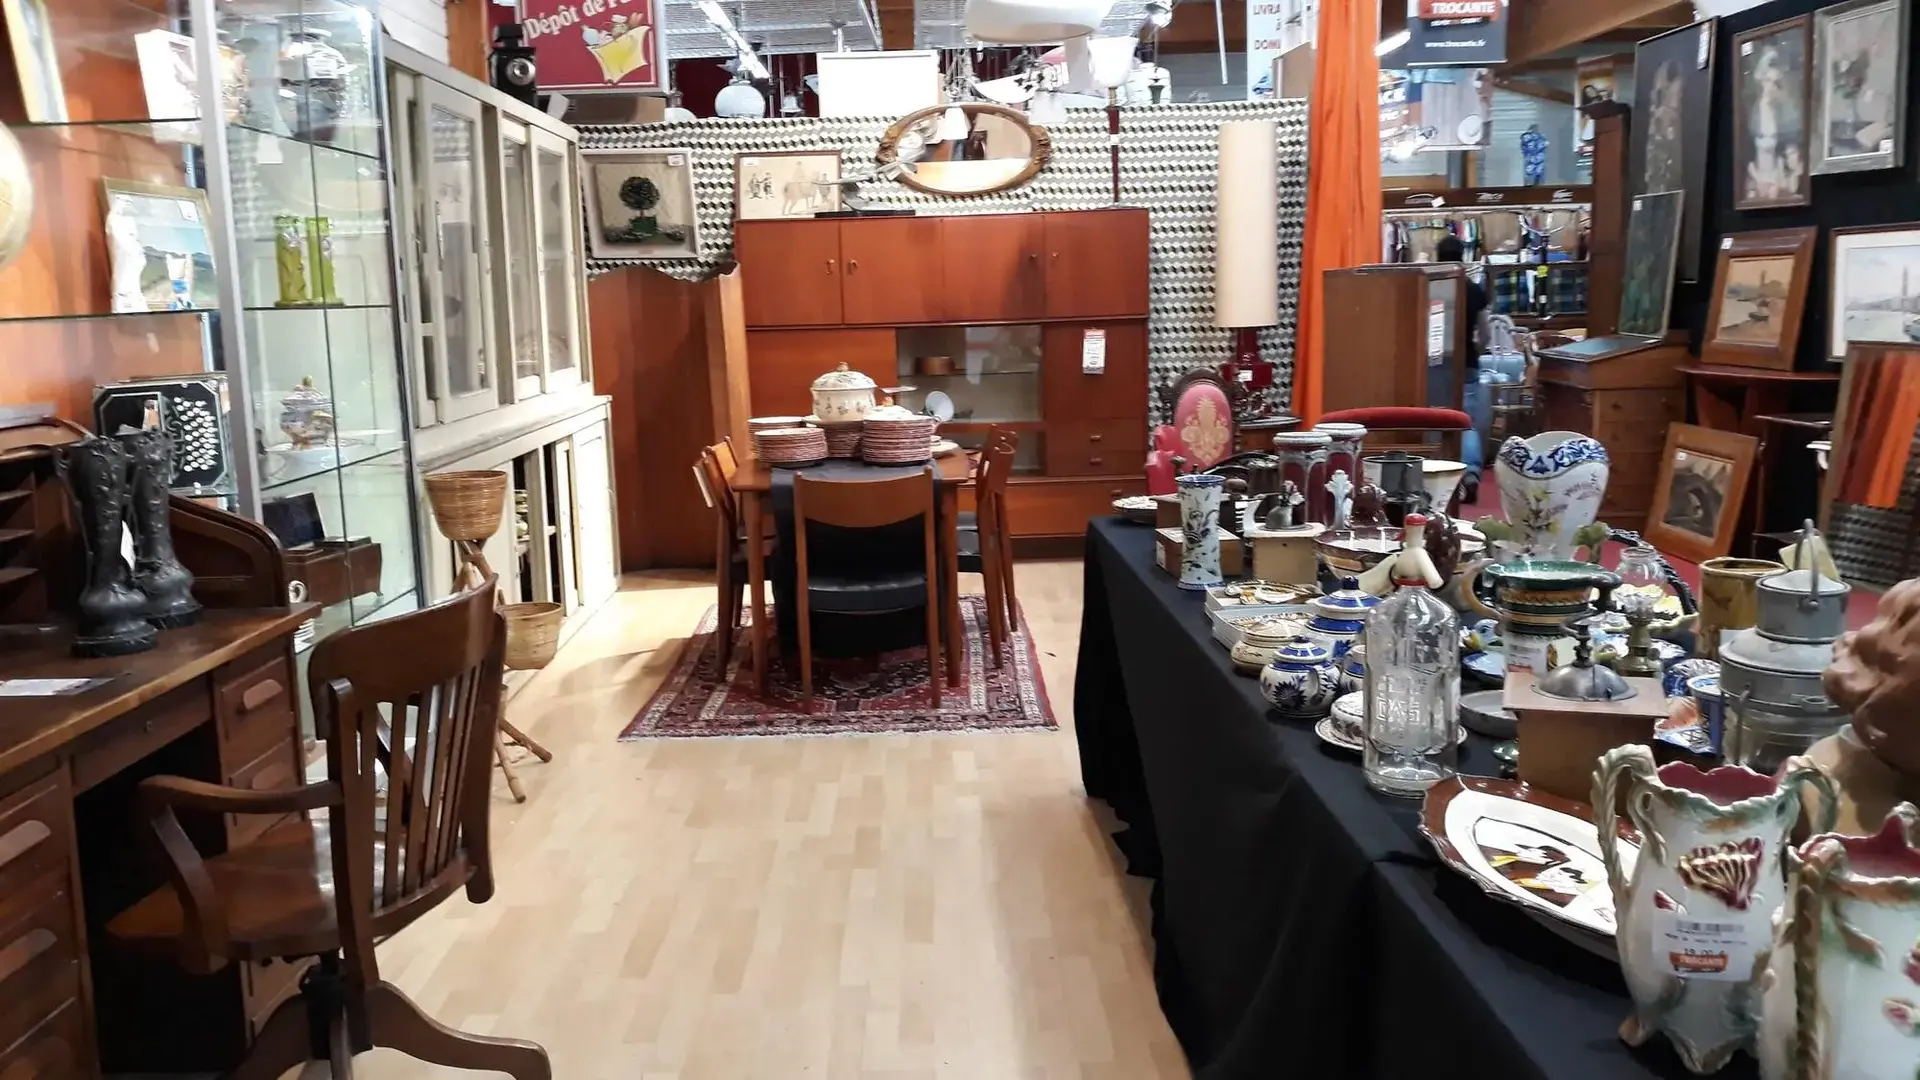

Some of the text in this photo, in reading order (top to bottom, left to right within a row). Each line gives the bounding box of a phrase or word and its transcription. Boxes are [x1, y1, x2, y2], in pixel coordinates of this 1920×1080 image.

[523, 0, 606, 39] Dépôt de
[1431, 1, 1496, 15] TROCANTE
